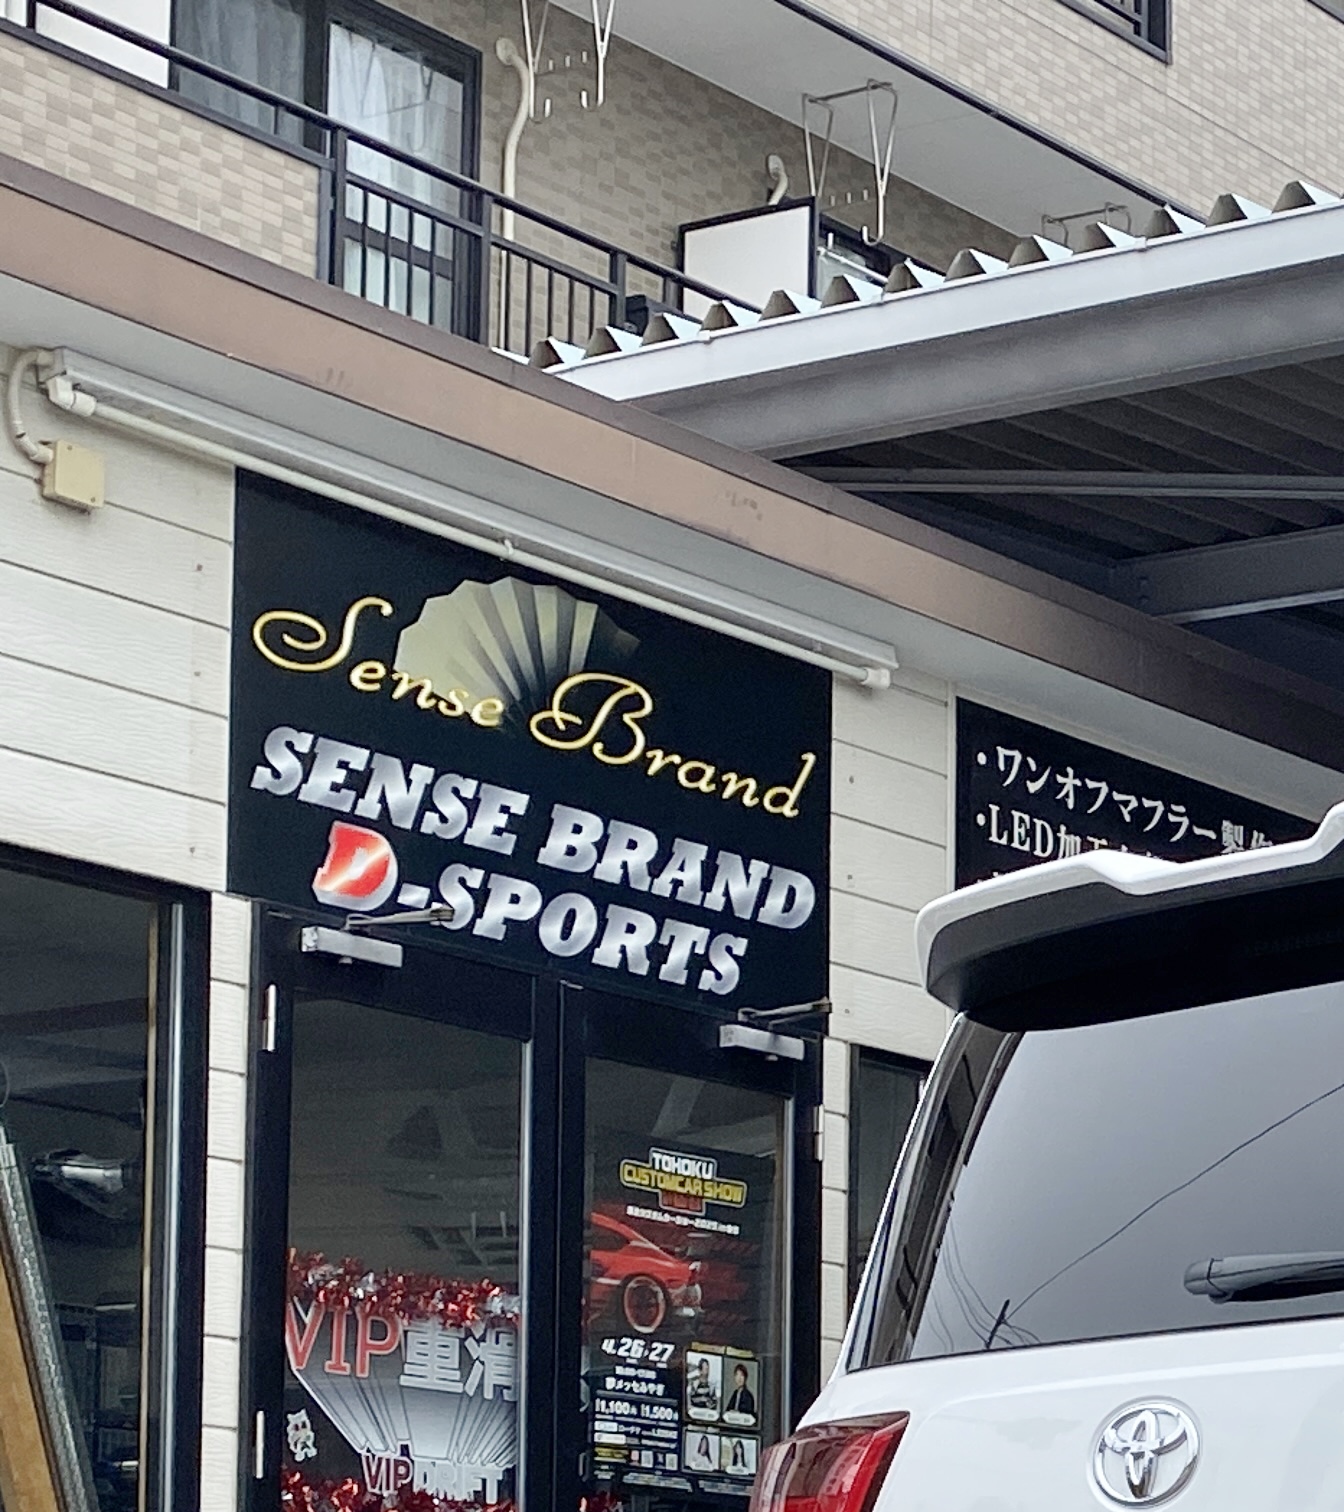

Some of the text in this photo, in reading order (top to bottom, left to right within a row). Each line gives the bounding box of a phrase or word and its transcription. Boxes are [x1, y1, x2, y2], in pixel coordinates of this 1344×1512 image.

[253, 596, 817, 818] Sense Brand
[250, 725, 816, 930] SENSE BRAND
[652, 1152, 714, 1180] TOHOKU
